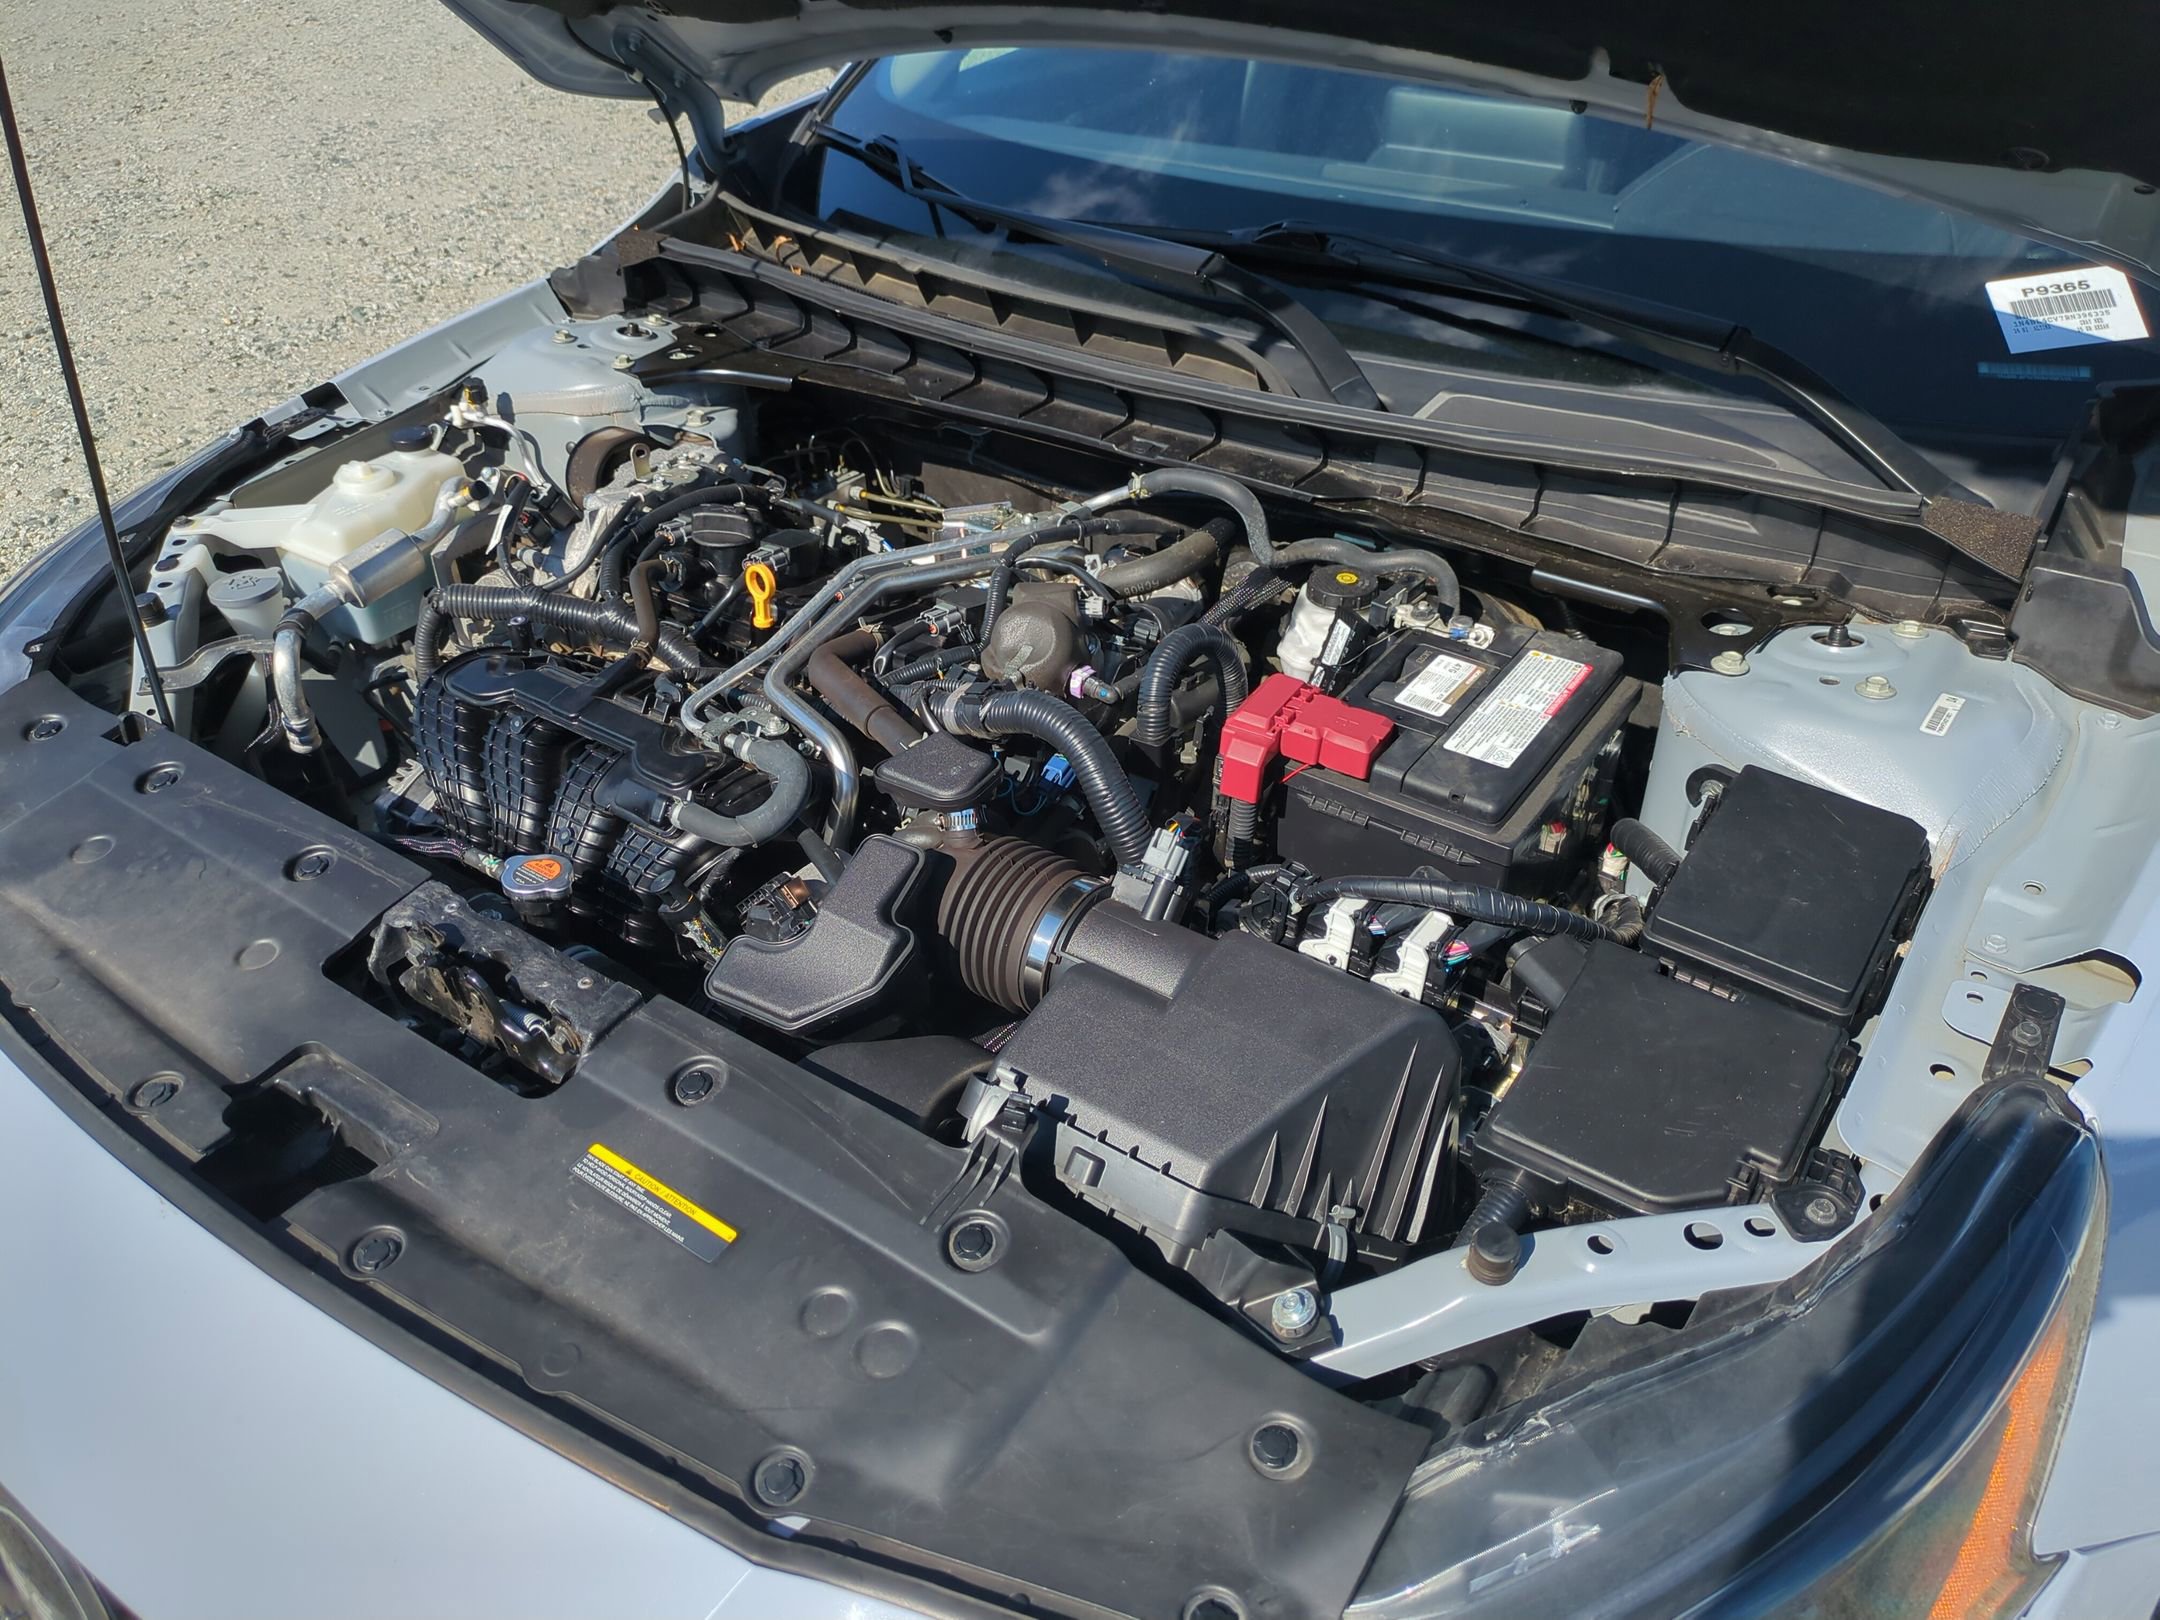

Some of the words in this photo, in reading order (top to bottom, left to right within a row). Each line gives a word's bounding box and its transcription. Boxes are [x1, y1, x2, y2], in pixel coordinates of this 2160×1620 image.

[2021, 280, 2091, 298] P9365
[634, 1173, 660, 1193] CAUTION
[665, 1191, 696, 1216] ATTENTION
